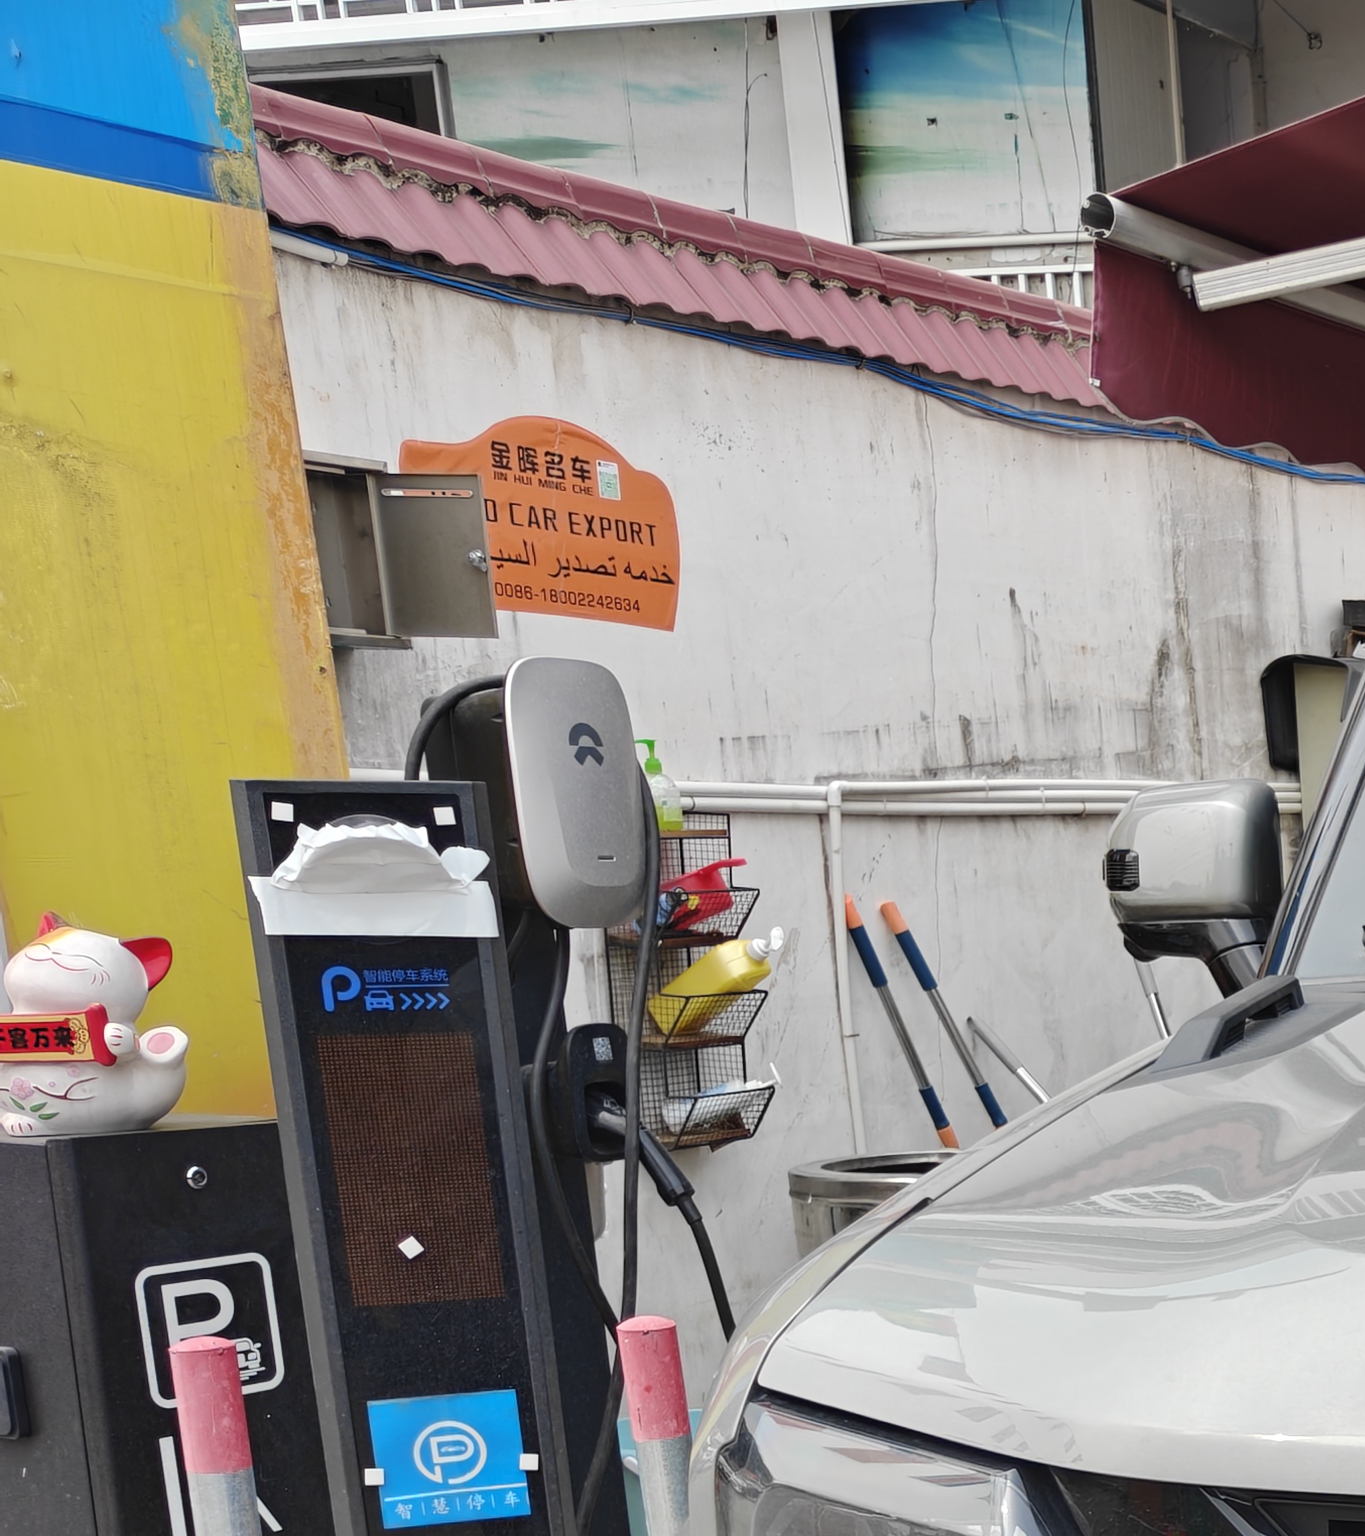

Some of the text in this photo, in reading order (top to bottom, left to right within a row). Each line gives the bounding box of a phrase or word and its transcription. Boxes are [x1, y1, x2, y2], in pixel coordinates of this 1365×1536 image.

[491, 440, 592, 484] 金晖名车
[493, 471, 594, 497] JIN HUI MING CHE
[509, 502, 559, 533] CAR
[568, 511, 657, 547] EXPORT
[548, 555, 618, 579] تصدير
[494, 582, 641, 613] 0086-18002242634
[362, 967, 449, 983] 智能停车系统
[160, 1278, 235, 1343] P
